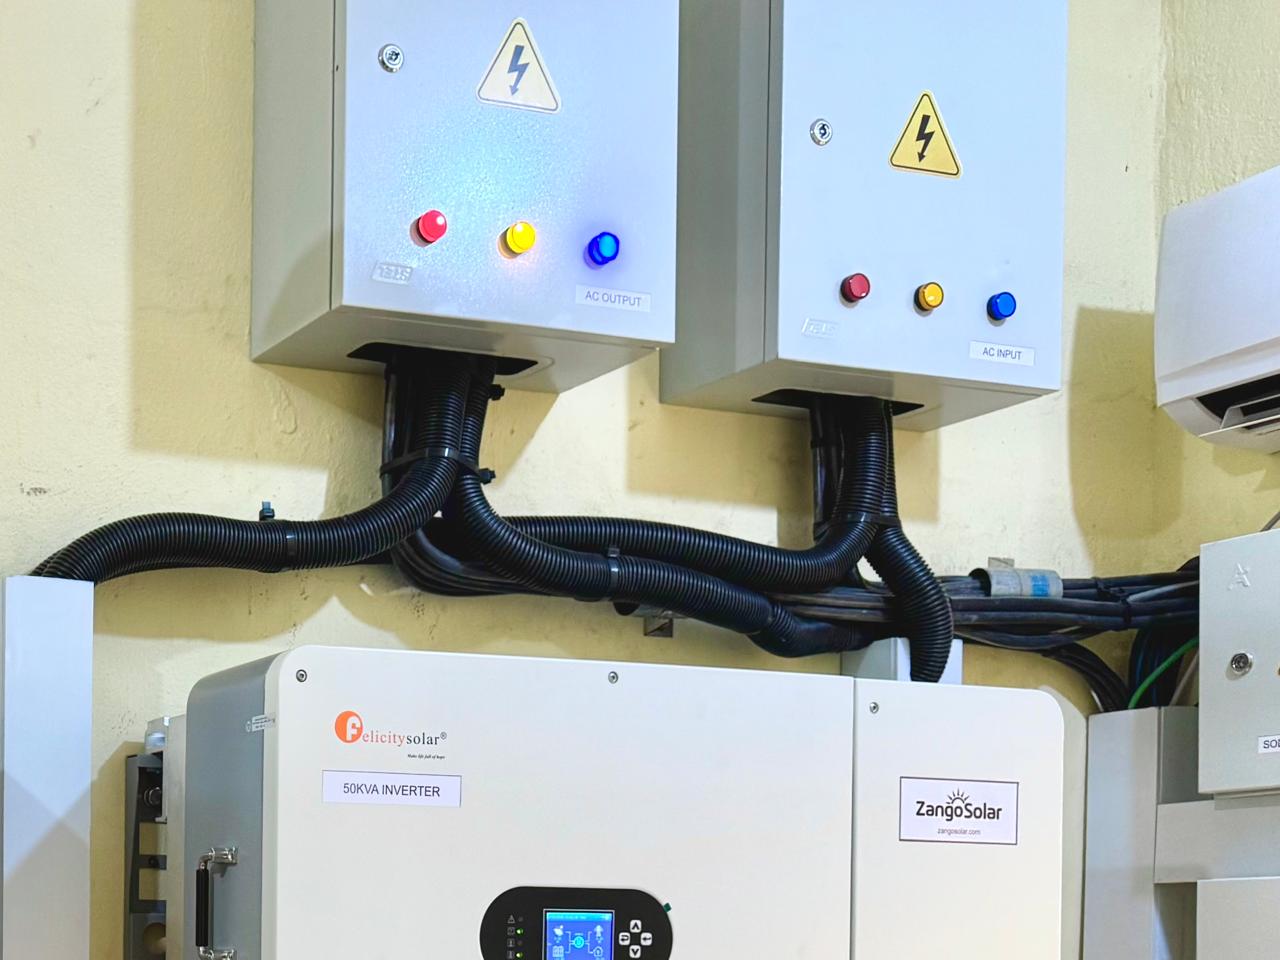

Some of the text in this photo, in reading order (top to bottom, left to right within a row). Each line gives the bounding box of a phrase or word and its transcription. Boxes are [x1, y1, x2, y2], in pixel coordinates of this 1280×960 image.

[585, 290, 642, 307] AC OUTPUT
[982, 347, 1022, 361] AC INPUT
[343, 782, 441, 797] 50KVA INVERTER
[915, 800, 1002, 821] ZangoSolar
[937, 827, 981, 835] zangosolar.com
